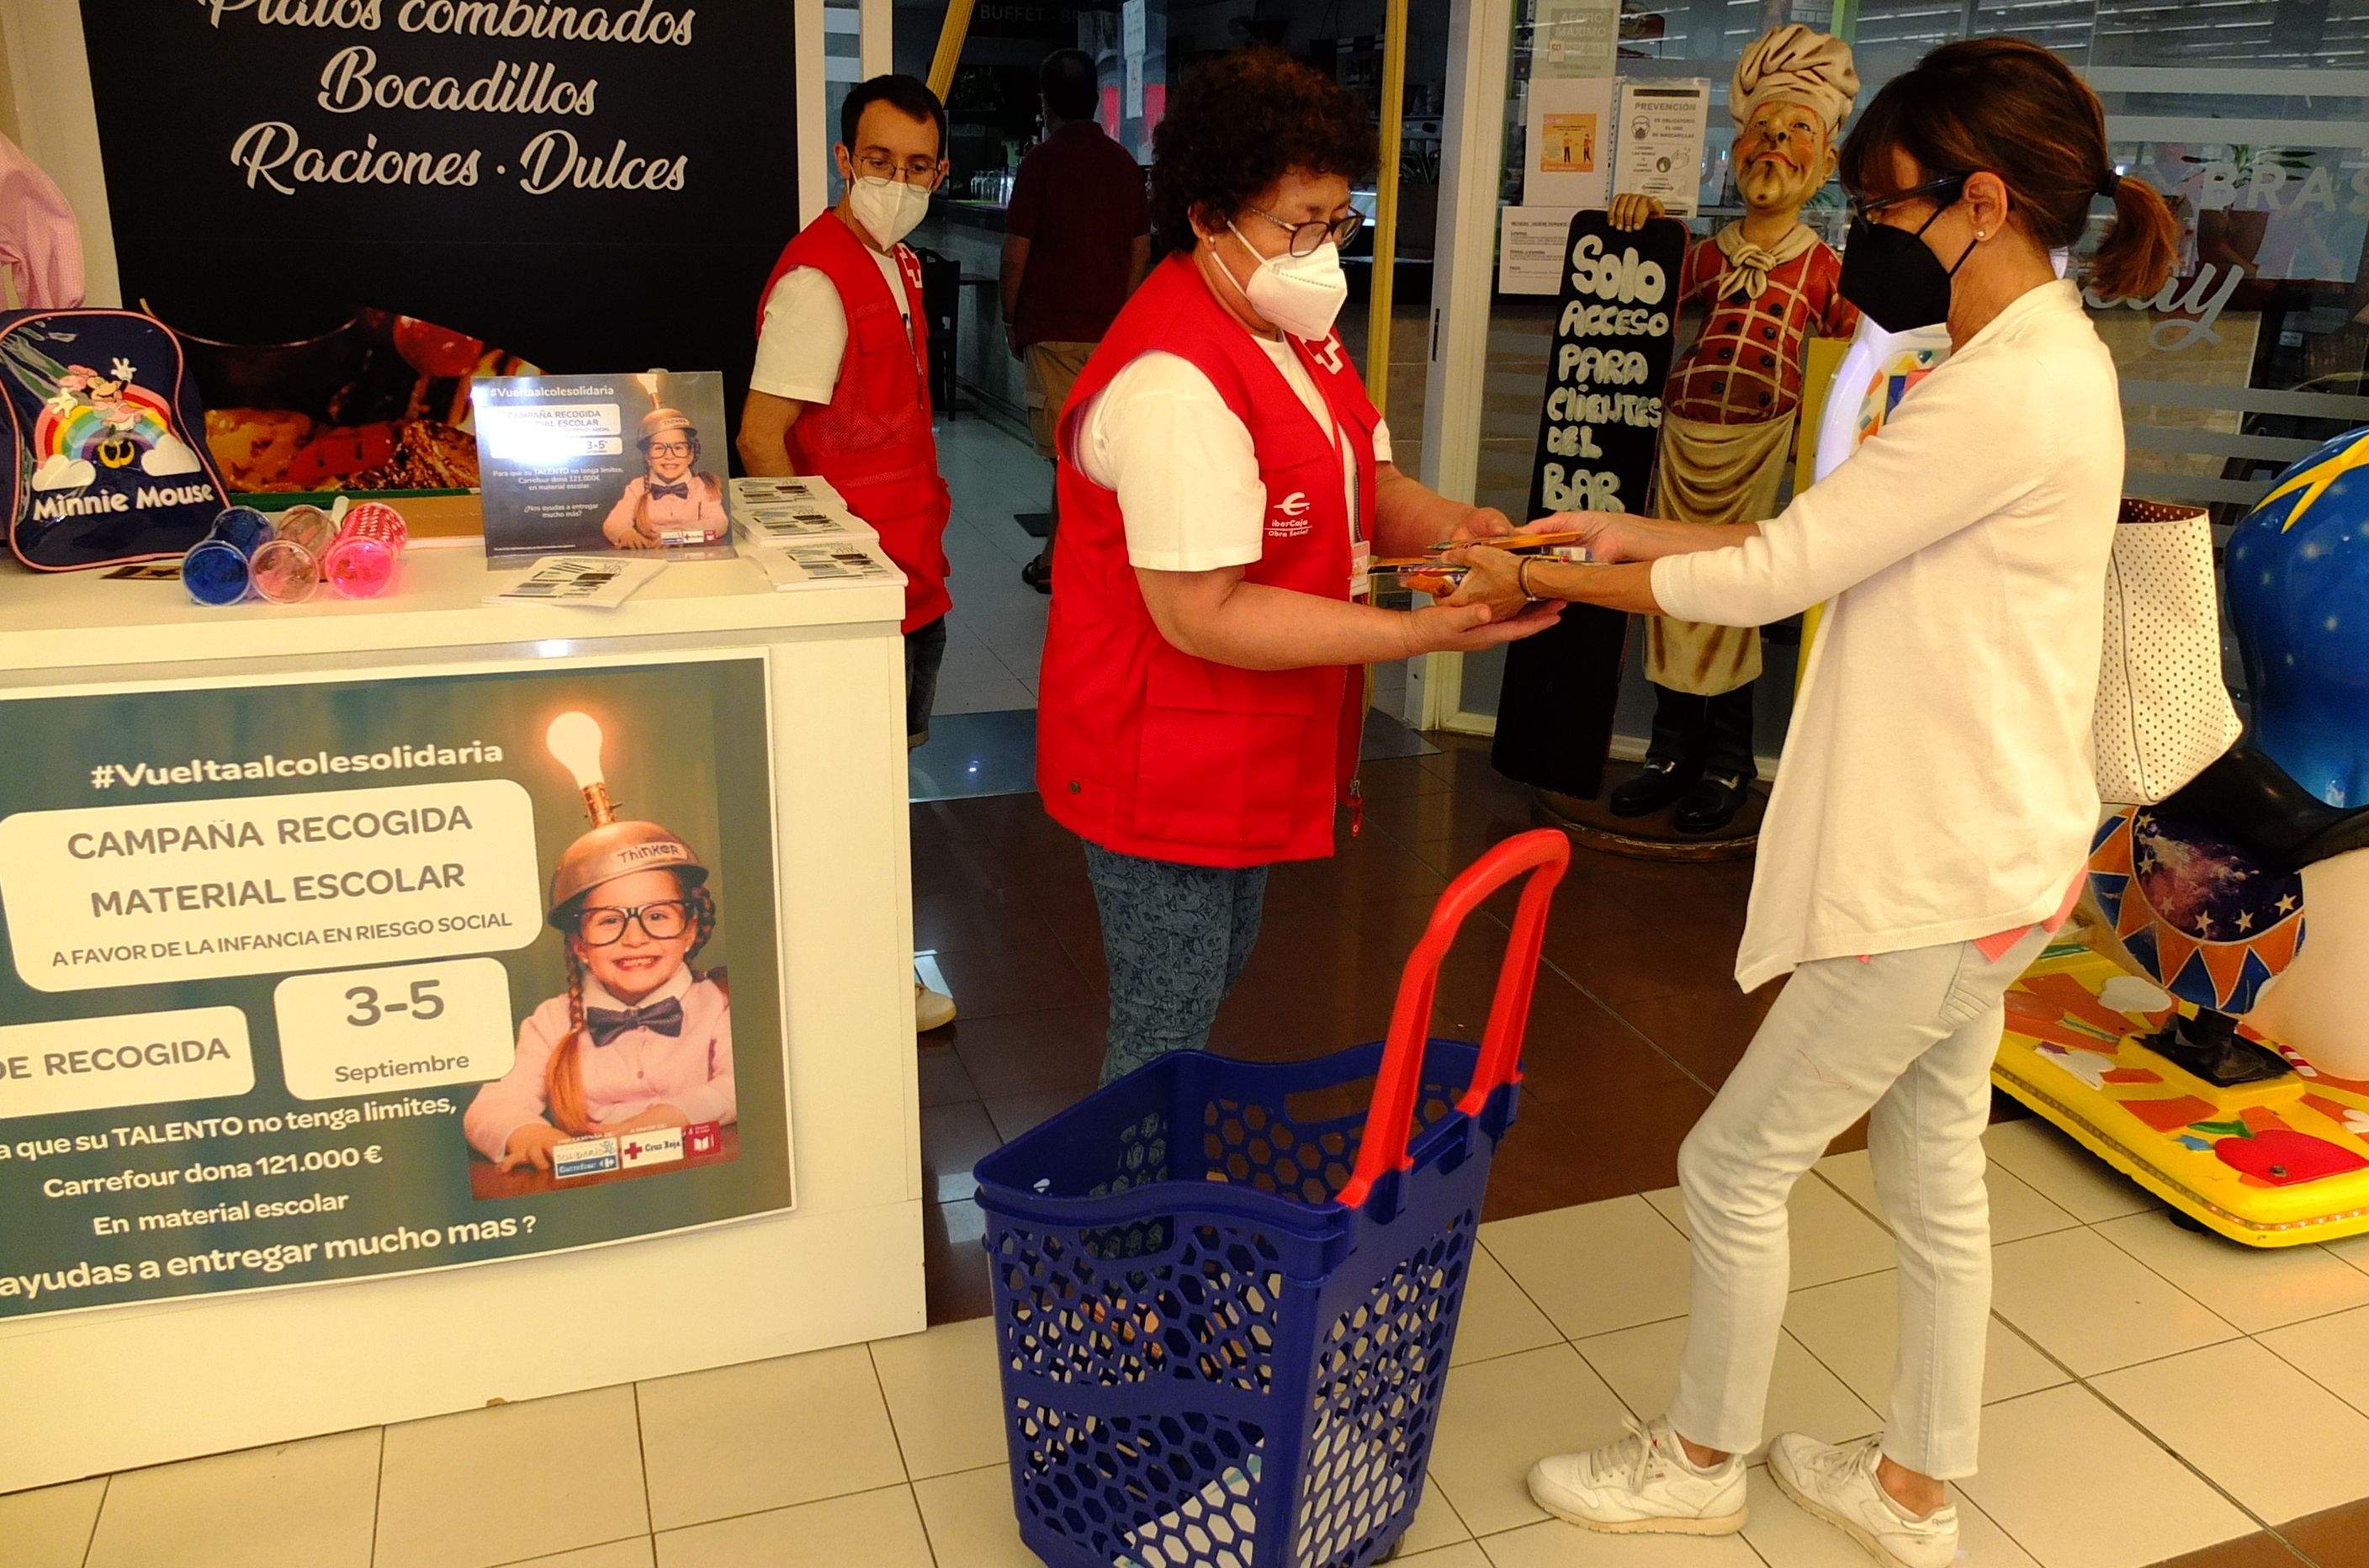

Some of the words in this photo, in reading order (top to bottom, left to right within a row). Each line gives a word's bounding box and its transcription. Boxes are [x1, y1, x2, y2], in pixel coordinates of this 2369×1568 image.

[399, 0, 697, 45] combinados
[318, 45, 597, 116] Bocadillos
[1634, 102, 1696, 112] PREVENCIÓN
[231, 121, 482, 195] Raciones
[519, 129, 688, 195] Dulces
[1571, 234, 1666, 305] Solo
[1559, 299, 1669, 337] ACCESO
[1558, 343, 1649, 384] PARA
[554, 410, 602, 418] RECOGIDA
[557, 418, 599, 427] ESCOLAR
[1546, 426, 1603, 459] DEL
[534, 467, 567, 475] TALENTO
[1542, 462, 1625, 513] BAR
[33, 488, 130, 521] Minnie
[135, 484, 215, 510] Mouse
[542, 504, 565, 512] ayudas
[572, 503, 599, 511] entregar
[92, 741, 504, 789] #Vueltaalcolesolidaria
[68, 818, 264, 860] CAMPAÑA
[278, 805, 473, 845] RECOGIDA
[91, 879, 287, 918] MATERIAL
[294, 862, 465, 902] ESCOLAR
[52, 951, 69, 967] A
[72, 946, 147, 965] FAVOR
[152, 942, 180, 959] DE
[186, 938, 215, 956] LA
[219, 930, 320, 953] INFANCIA
[324, 927, 352, 944] EN
[357, 919, 434, 940] RIESGO
[438, 912, 512, 933] SOCIAL
[345, 979, 444, 1026] 3-5
[0, 1055, 32, 1080] E
[45, 1037, 231, 1077] RECOGIDA
[335, 1052, 469, 1085] Septiembre
[16, 1136, 72, 1162] que
[76, 1131, 109, 1151] su
[112, 1115, 244, 1147] TALENTO
[248, 1115, 281, 1134] no
[286, 1106, 361, 1134] tenga
[364, 1095, 457, 1122] limites,
[644, 1143, 663, 1152] Cruz
[664, 1140, 681, 1150] Roja
[44, 1168, 180, 1199] Carrefour
[185, 1158, 252, 1183] dona
[255, 1147, 360, 1176] 121.000
[363, 1145, 383, 1164] €
[93, 1216, 130, 1236] En
[139, 1200, 250, 1231] material
[255, 1191, 349, 1219] escolar
[0, 1260, 133, 1299] ayudas
[139, 1259, 161, 1279] a
[167, 1242, 318, 1277] entregar
[325, 1226, 442, 1260] mucho
[448, 1216, 517, 1245] mas
[522, 1214, 537, 1233] ?
